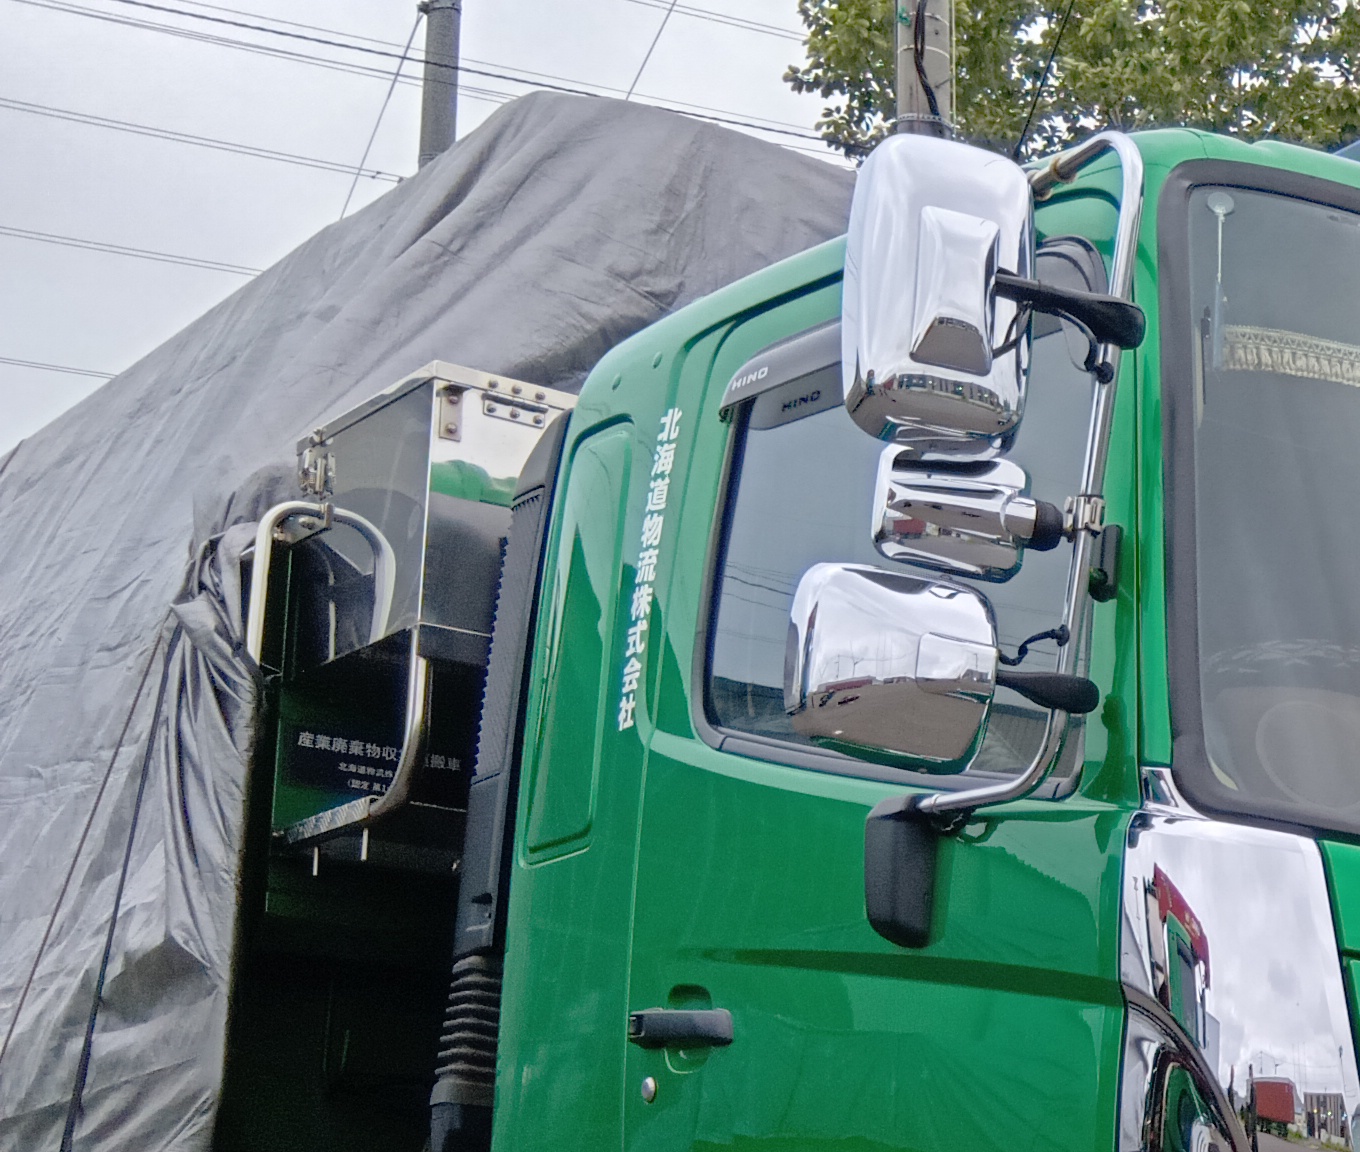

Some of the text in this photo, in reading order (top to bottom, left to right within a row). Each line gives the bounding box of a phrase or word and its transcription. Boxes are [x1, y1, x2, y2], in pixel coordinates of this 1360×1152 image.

[731, 366, 769, 391] HINO
[618, 406, 683, 732] 北海道物流株式会社
[297, 730, 463, 772] 産業廃棄物収搬車
